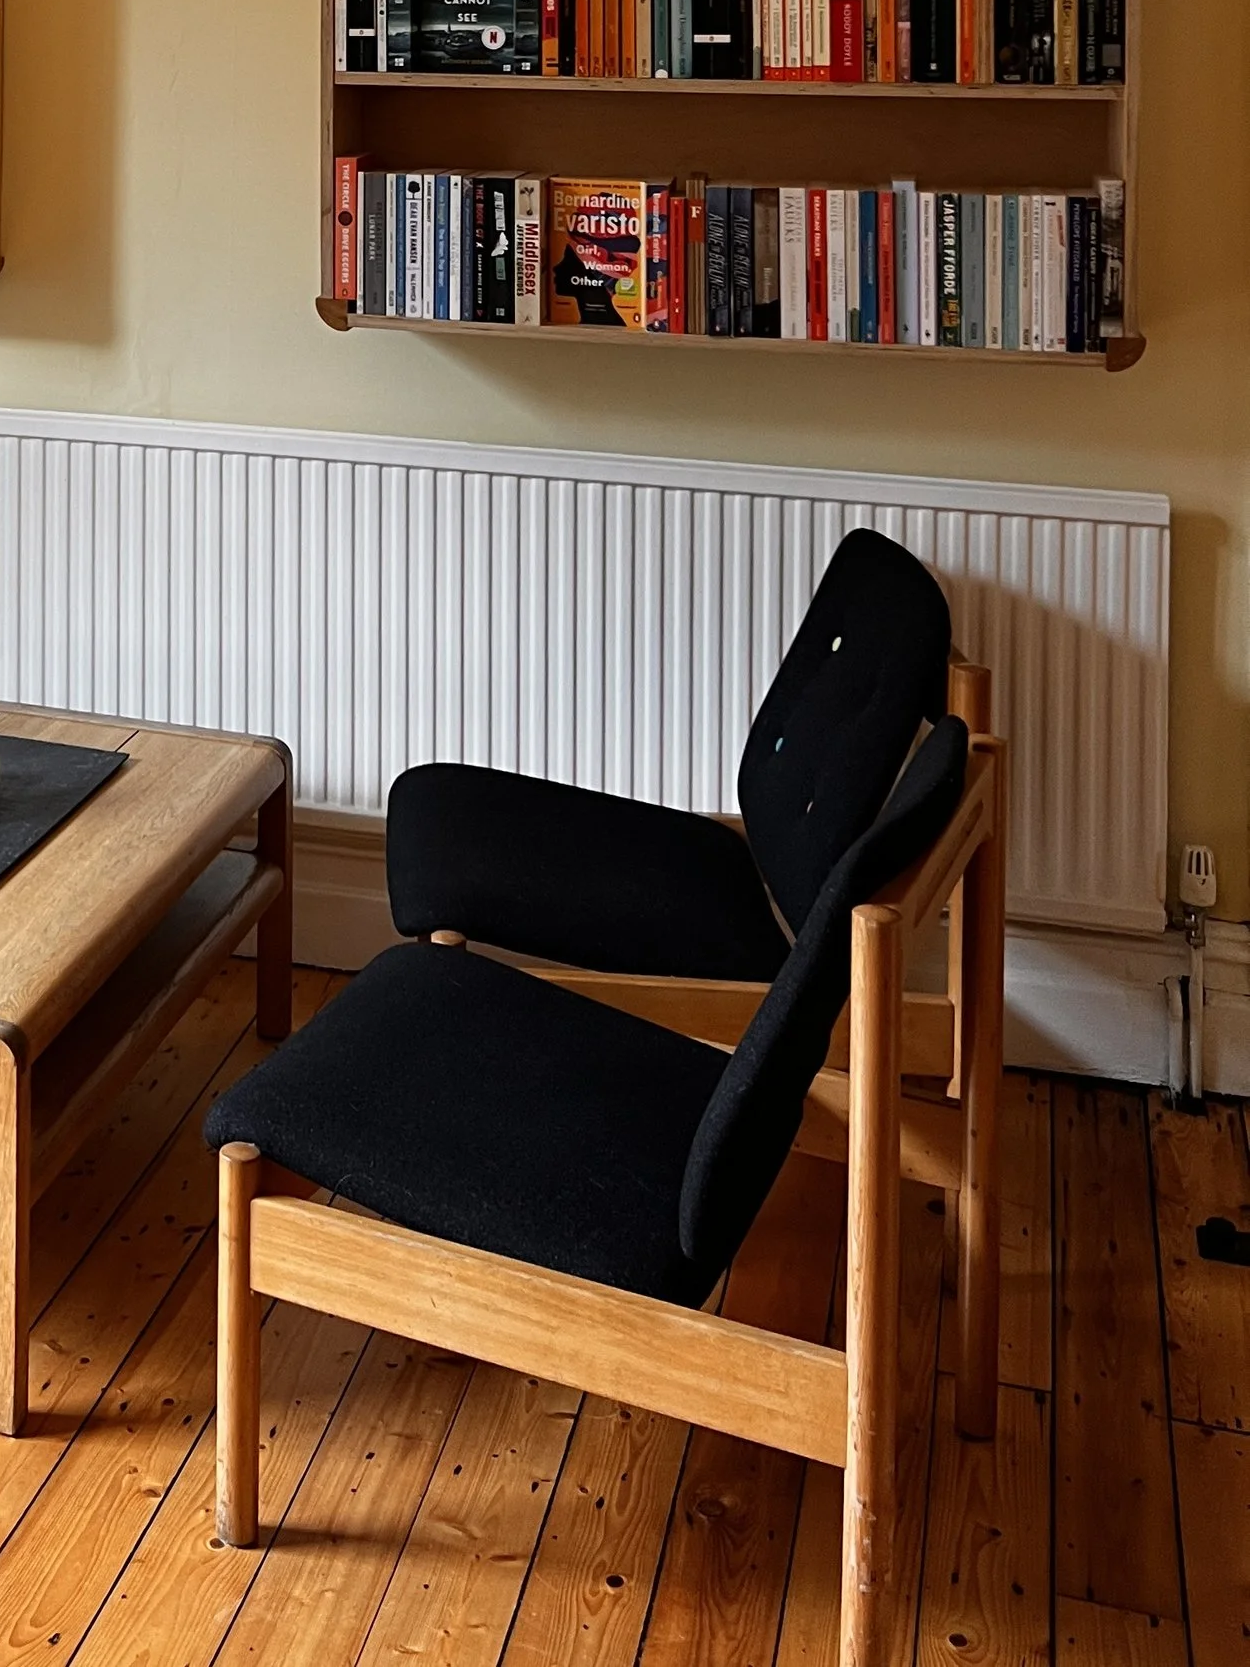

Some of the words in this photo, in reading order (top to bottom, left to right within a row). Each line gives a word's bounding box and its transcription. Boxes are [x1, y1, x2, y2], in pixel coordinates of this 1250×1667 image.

[457, 12, 478, 22] SEE
[844, 3, 852, 35] RODDY
[489, 31, 498, 44] N
[844, 37, 852, 67] DOYLE
[341, 164, 350, 180] THE
[341, 182, 350, 208] CIRCLE
[554, 190, 640, 209] Bernardine
[409, 202, 417, 218] DEAR
[553, 207, 640, 236] Evaristo
[652, 193, 660, 232] Bernardine
[691, 205, 701, 218] F
[785, 195, 794, 244] FAULKS
[368, 214, 376, 239] LUNAR
[409, 220, 417, 237] EVAN
[708, 213, 724, 246] ALONE
[733, 215, 749, 247] ALONE
[943, 199, 956, 248] JASPER
[341, 228, 350, 250] DAVE
[368, 241, 376, 261] PARK
[409, 238, 417, 264] HANSEN
[576, 244, 601, 257] Girl,
[652, 233, 660, 263] Evaristo
[341, 252, 350, 283] EGGERS
[526, 223, 539, 295] Middlesex
[583, 260, 632, 273] Woman,
[708, 252, 724, 285] BERLIN
[733, 254, 749, 289] BERLIN
[943, 249, 956, 295] FFORDE
[570, 276, 604, 287] Other
